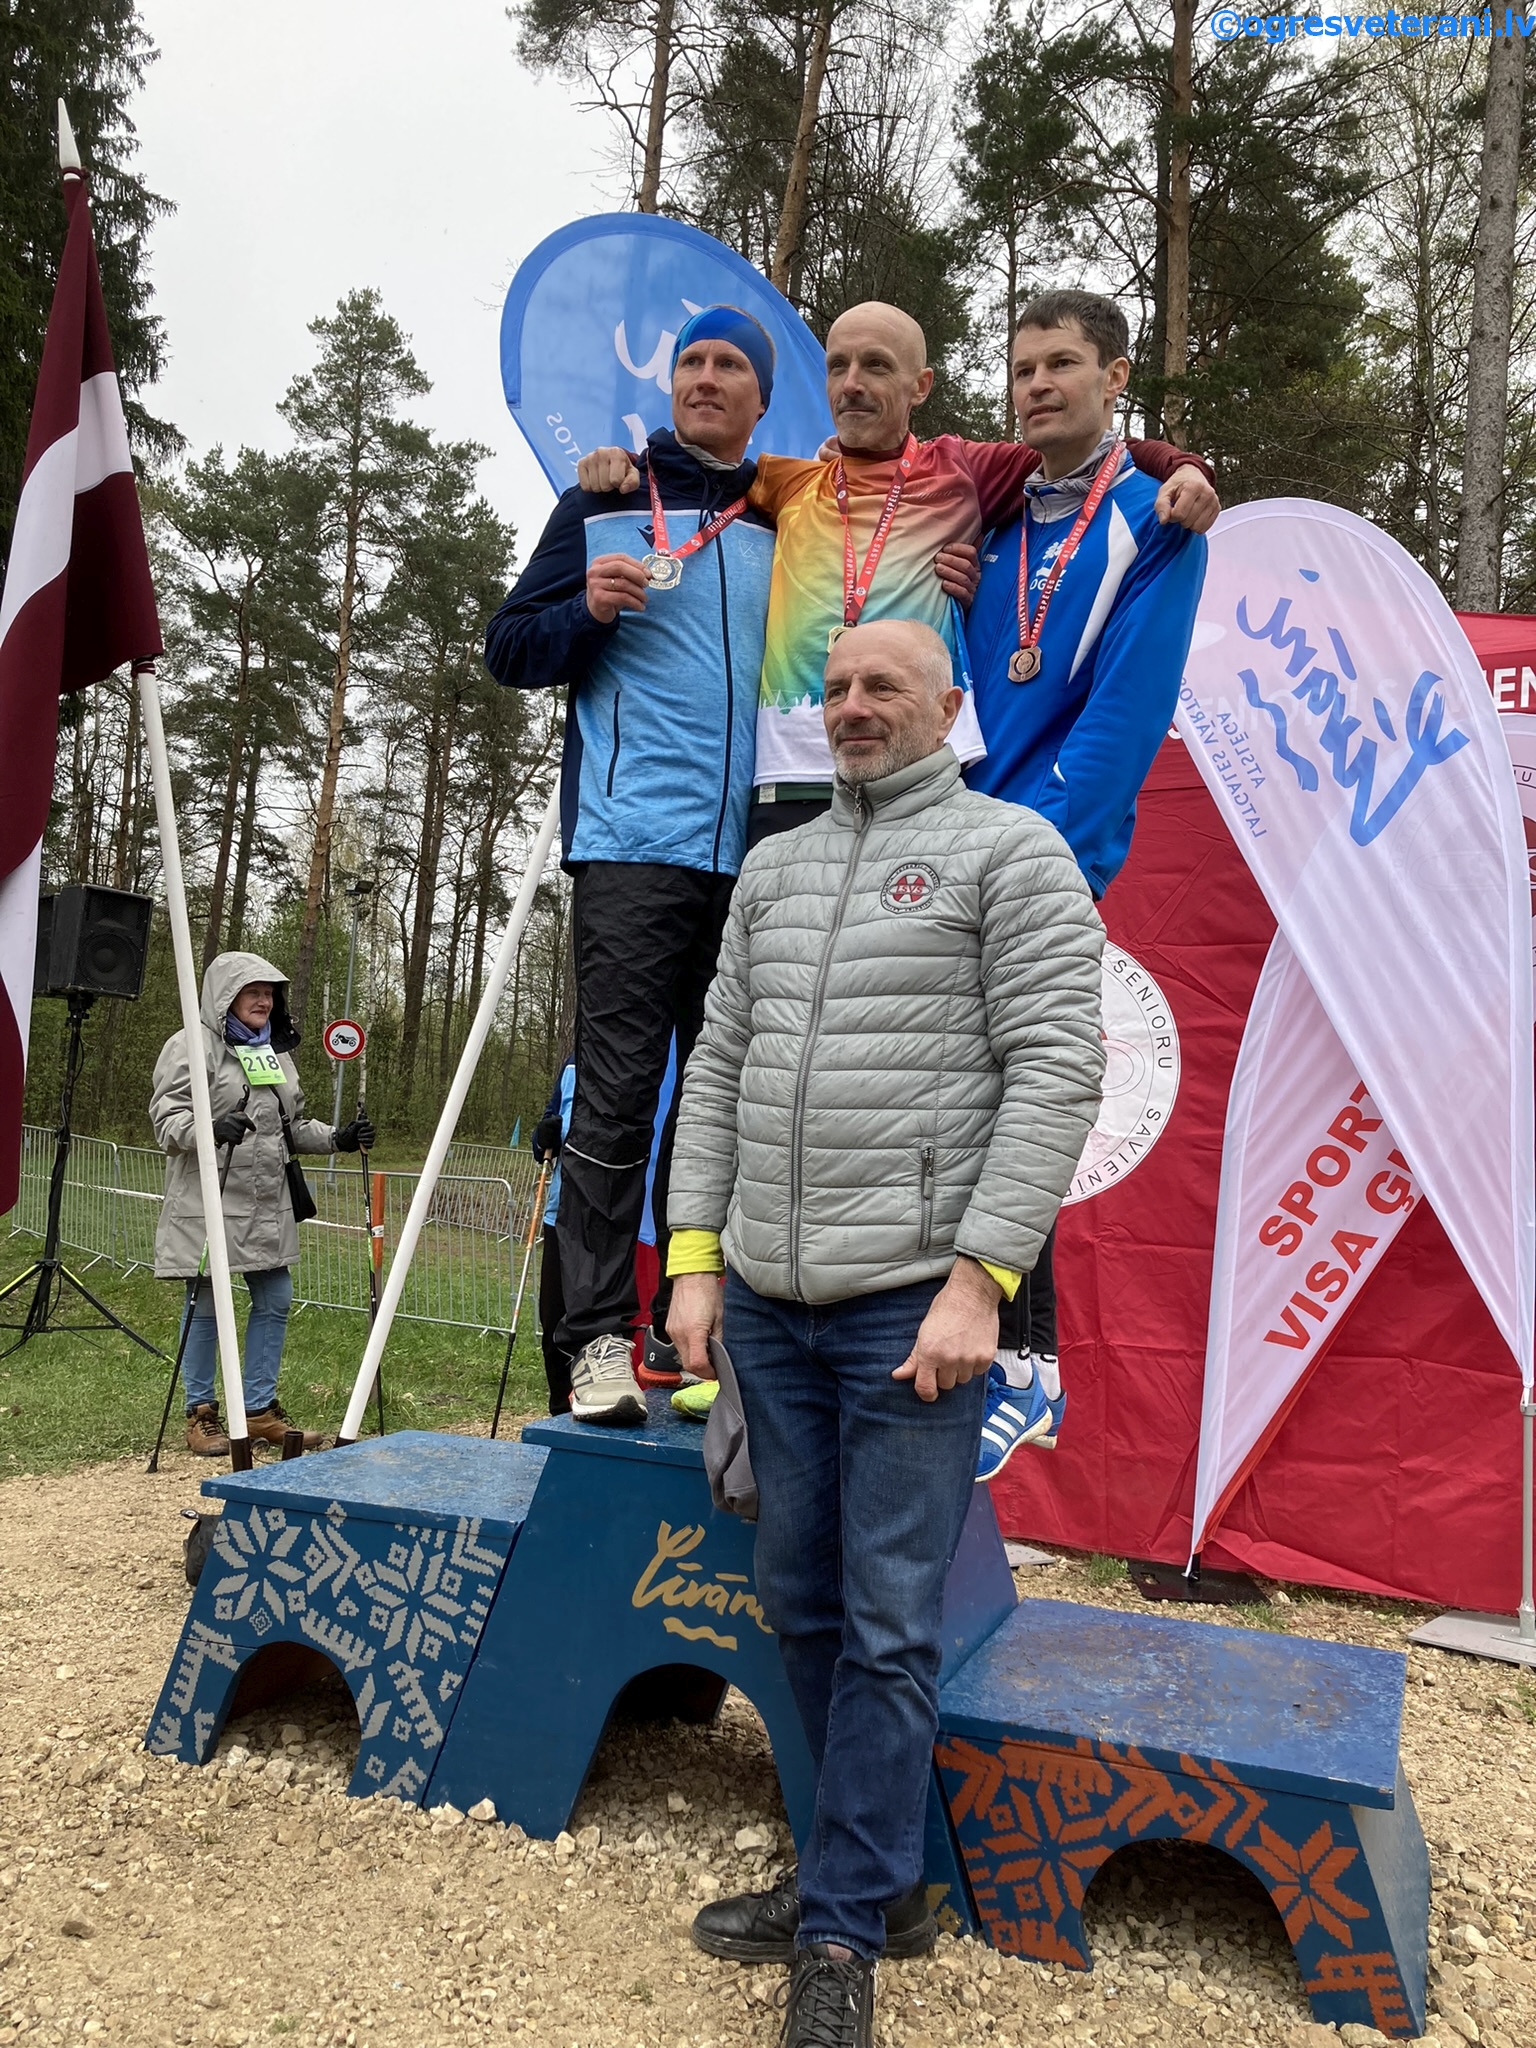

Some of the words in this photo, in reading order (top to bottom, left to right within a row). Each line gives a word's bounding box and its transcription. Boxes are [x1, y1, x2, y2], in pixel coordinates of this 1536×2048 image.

[868, 543, 881, 563] LSVS
[875, 514, 891, 542] SPORTA
[1030, 578, 1063, 591] OGE
[1113, 959, 1172, 1069] SENIORU
[243, 1055, 280, 1072] 218
[1263, 1230, 1379, 1350] VISA
